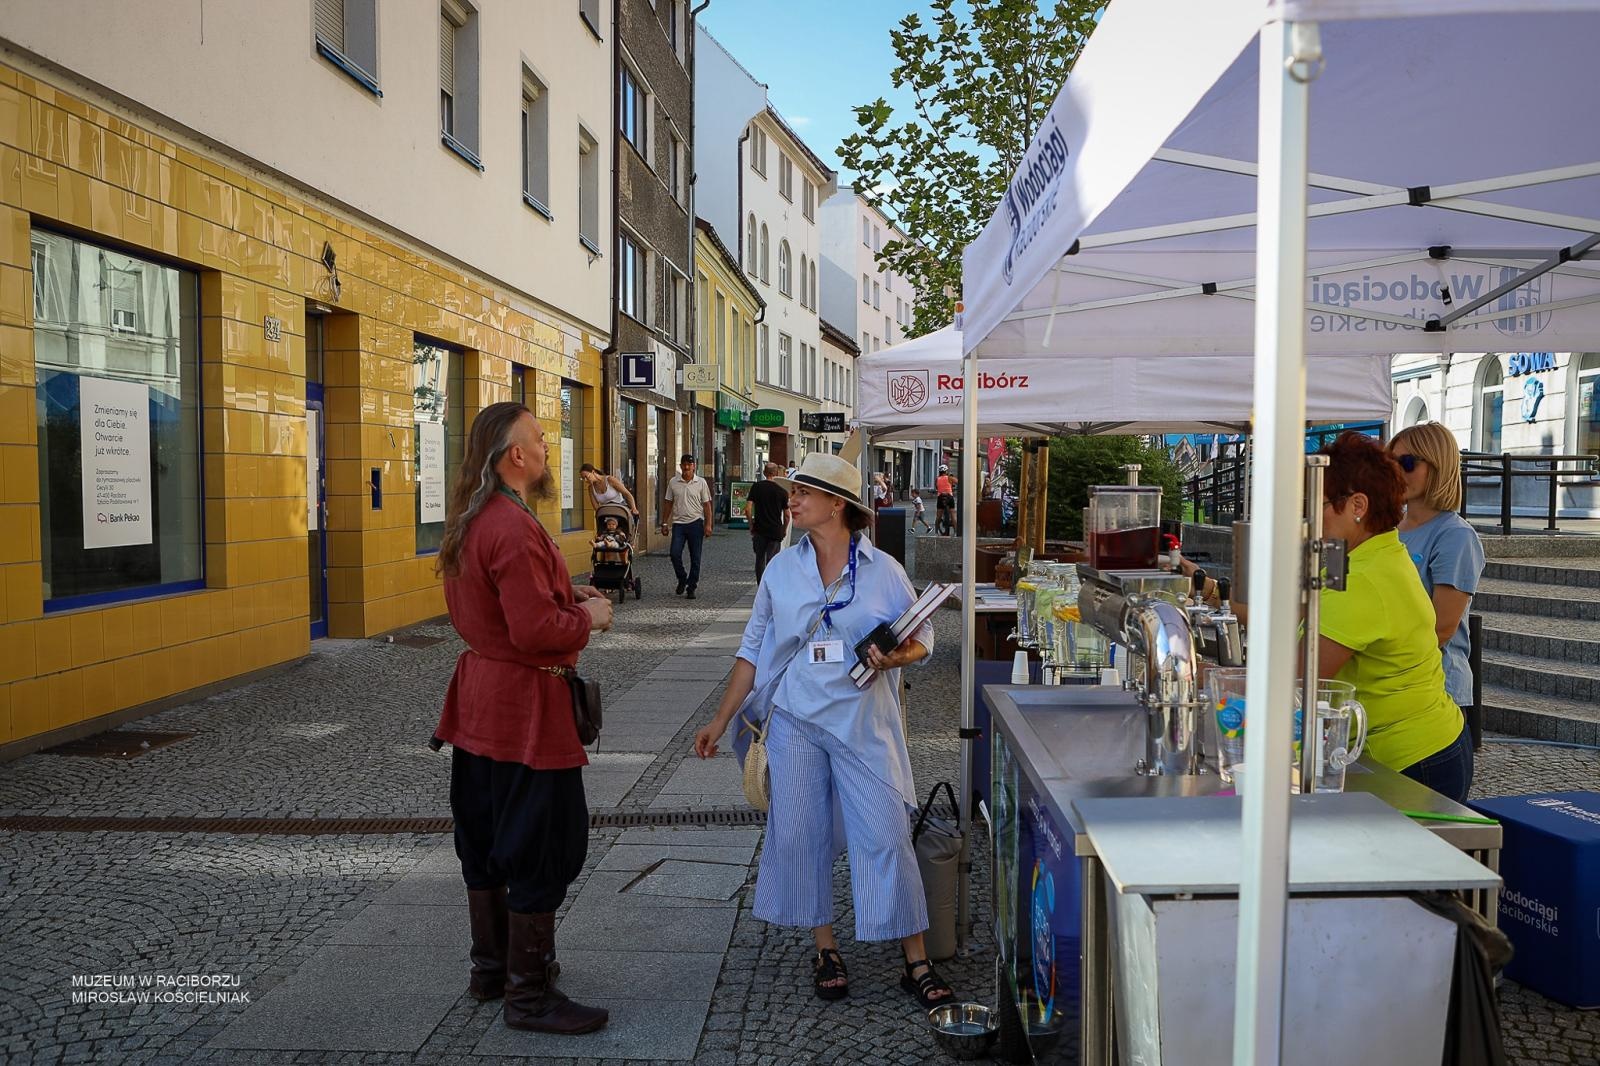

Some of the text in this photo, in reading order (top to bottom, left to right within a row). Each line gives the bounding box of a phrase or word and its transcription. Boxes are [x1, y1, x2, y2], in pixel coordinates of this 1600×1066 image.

[1014, 114, 1069, 217] Wodociągi
[629, 358, 646, 383] L
[1508, 352, 1557, 376] SOWA
[937, 372, 1029, 390] Raibórz
[937, 396, 962, 407] 1217
[94, 404, 128, 418] Zmieniamy
[94, 418, 105, 428] dla
[94, 431, 123, 442] Otwarcie
[95, 445, 105, 457] już
[110, 513, 140, 523] Bank Pekao
